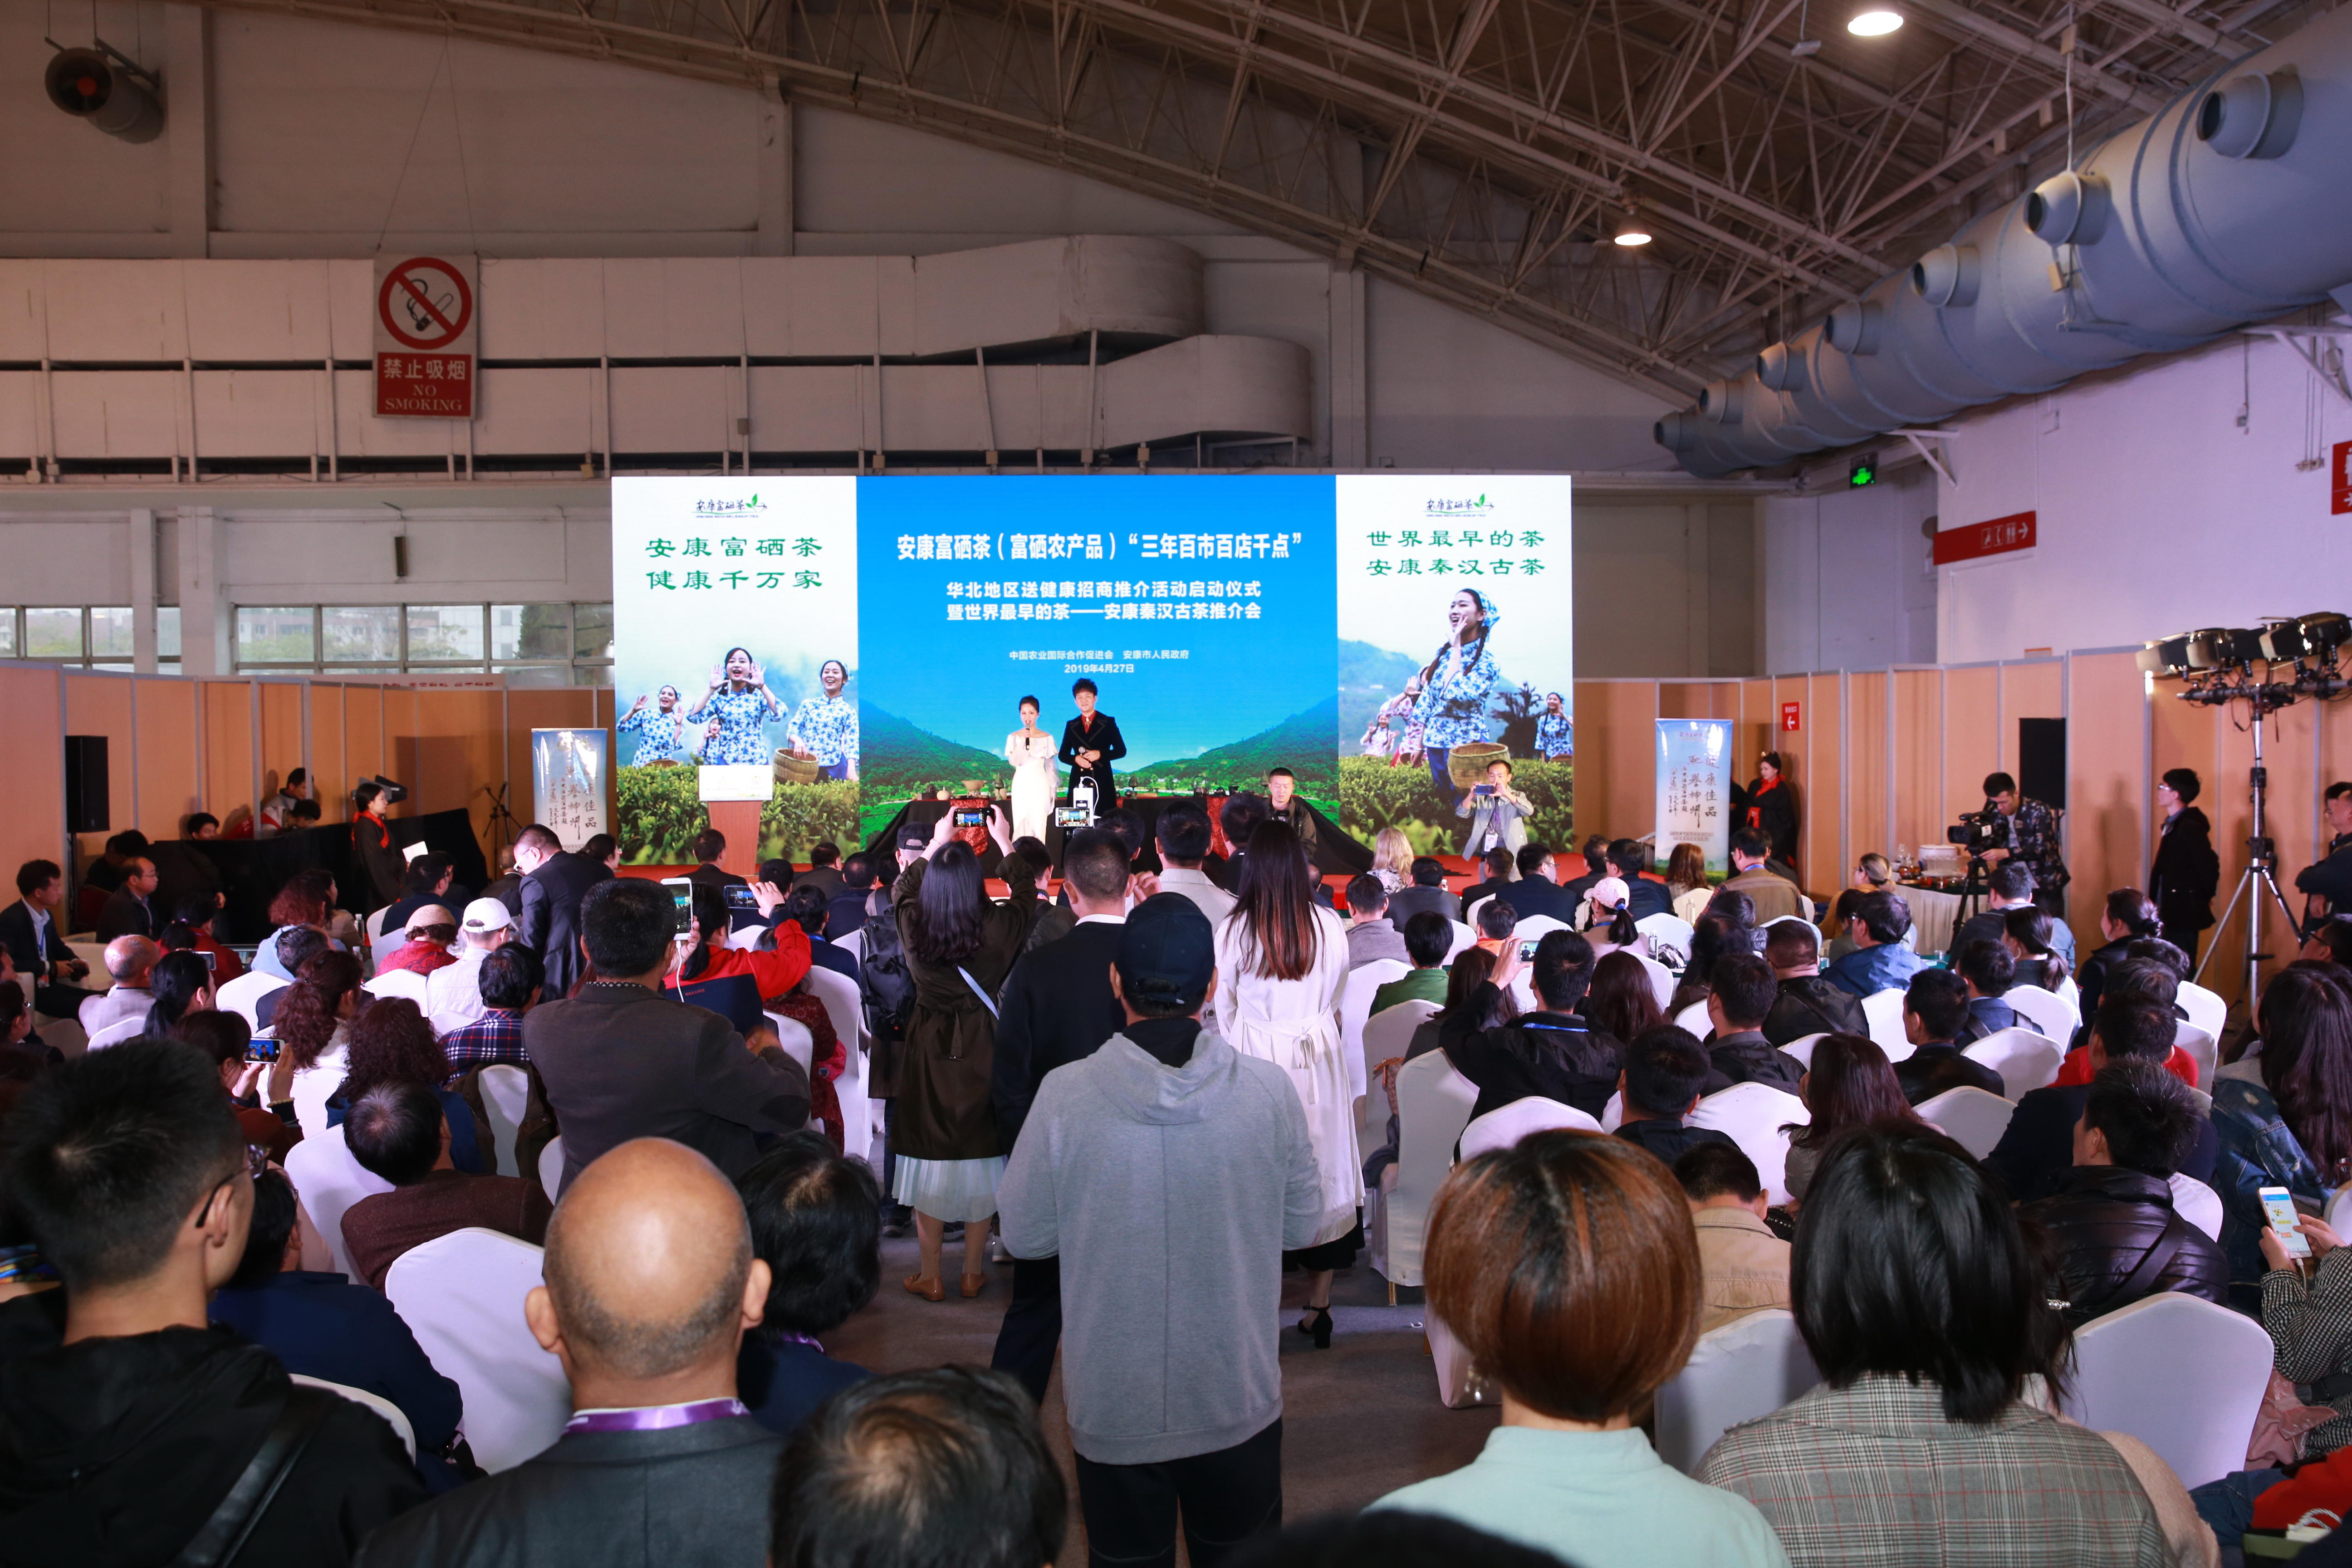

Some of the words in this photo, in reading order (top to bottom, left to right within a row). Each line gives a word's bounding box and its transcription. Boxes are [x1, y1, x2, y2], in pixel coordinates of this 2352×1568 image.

[384, 358, 466, 380] 禁止吸烟
[413, 384, 436, 396] NO
[386, 398, 462, 411] SMOKING
[646, 537, 823, 558] 安康富硒茶
[1367, 529, 1545, 548] 世界最早的茶
[1366, 559, 1545, 576] 安康秦汉古茶
[646, 570, 823, 590] 健康千万家
[946, 580, 1261, 599] 华北地区送健康招商推介活动启动仪式
[1009, 650, 1113, 660] 中国农业国际合作促进会
[1123, 649, 1189, 660] 安康市人民政府
[1064, 663, 1134, 674] 2019年4月27日
